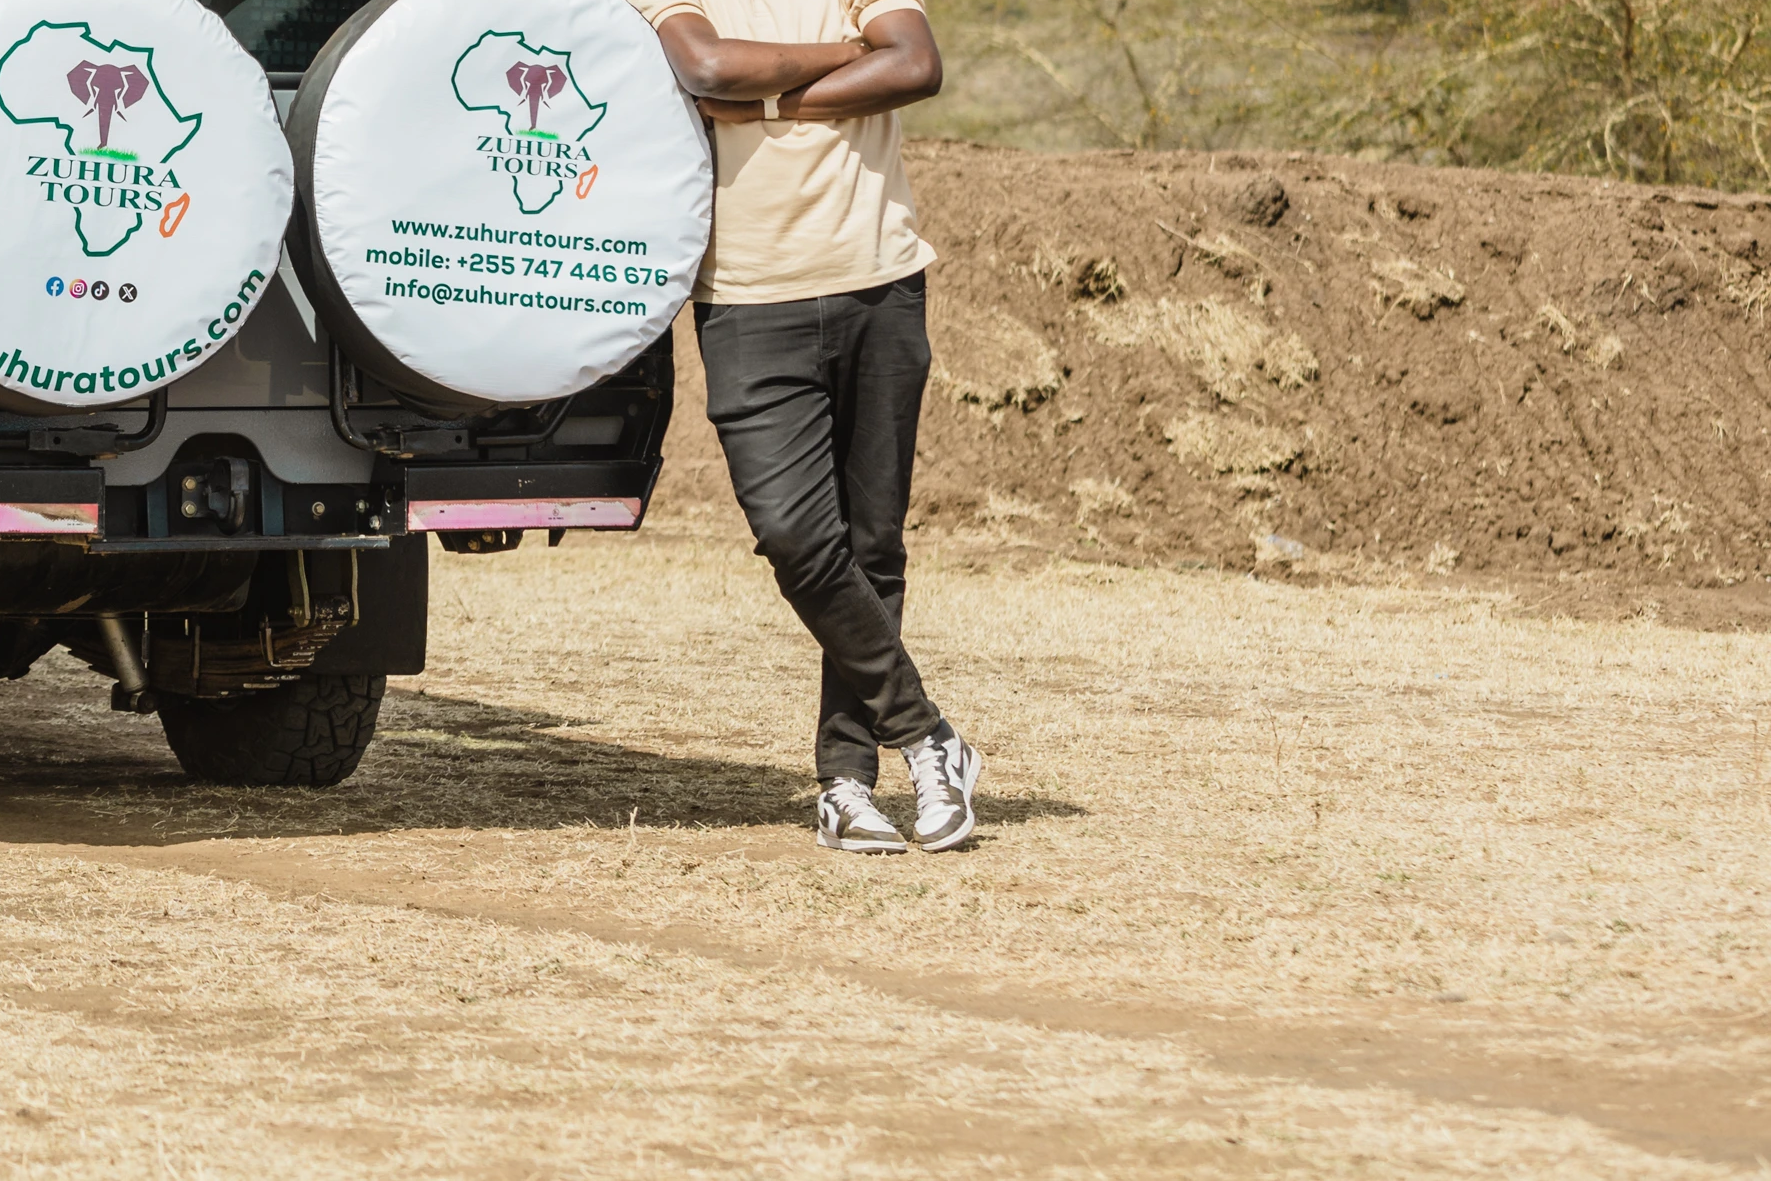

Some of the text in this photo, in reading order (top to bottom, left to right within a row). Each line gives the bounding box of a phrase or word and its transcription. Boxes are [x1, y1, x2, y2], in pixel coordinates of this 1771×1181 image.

[475, 135, 592, 162] ZUHURA
[25, 155, 182, 189] ZUHURA
[486, 155, 579, 180] TOURS
[40, 181, 163, 212] TOURS
[391, 219, 648, 256] www.zuhuratours.com
[365, 246, 669, 287] mobile: +255 747 446 676
[384, 275, 648, 317] info@zuhuratours.com
